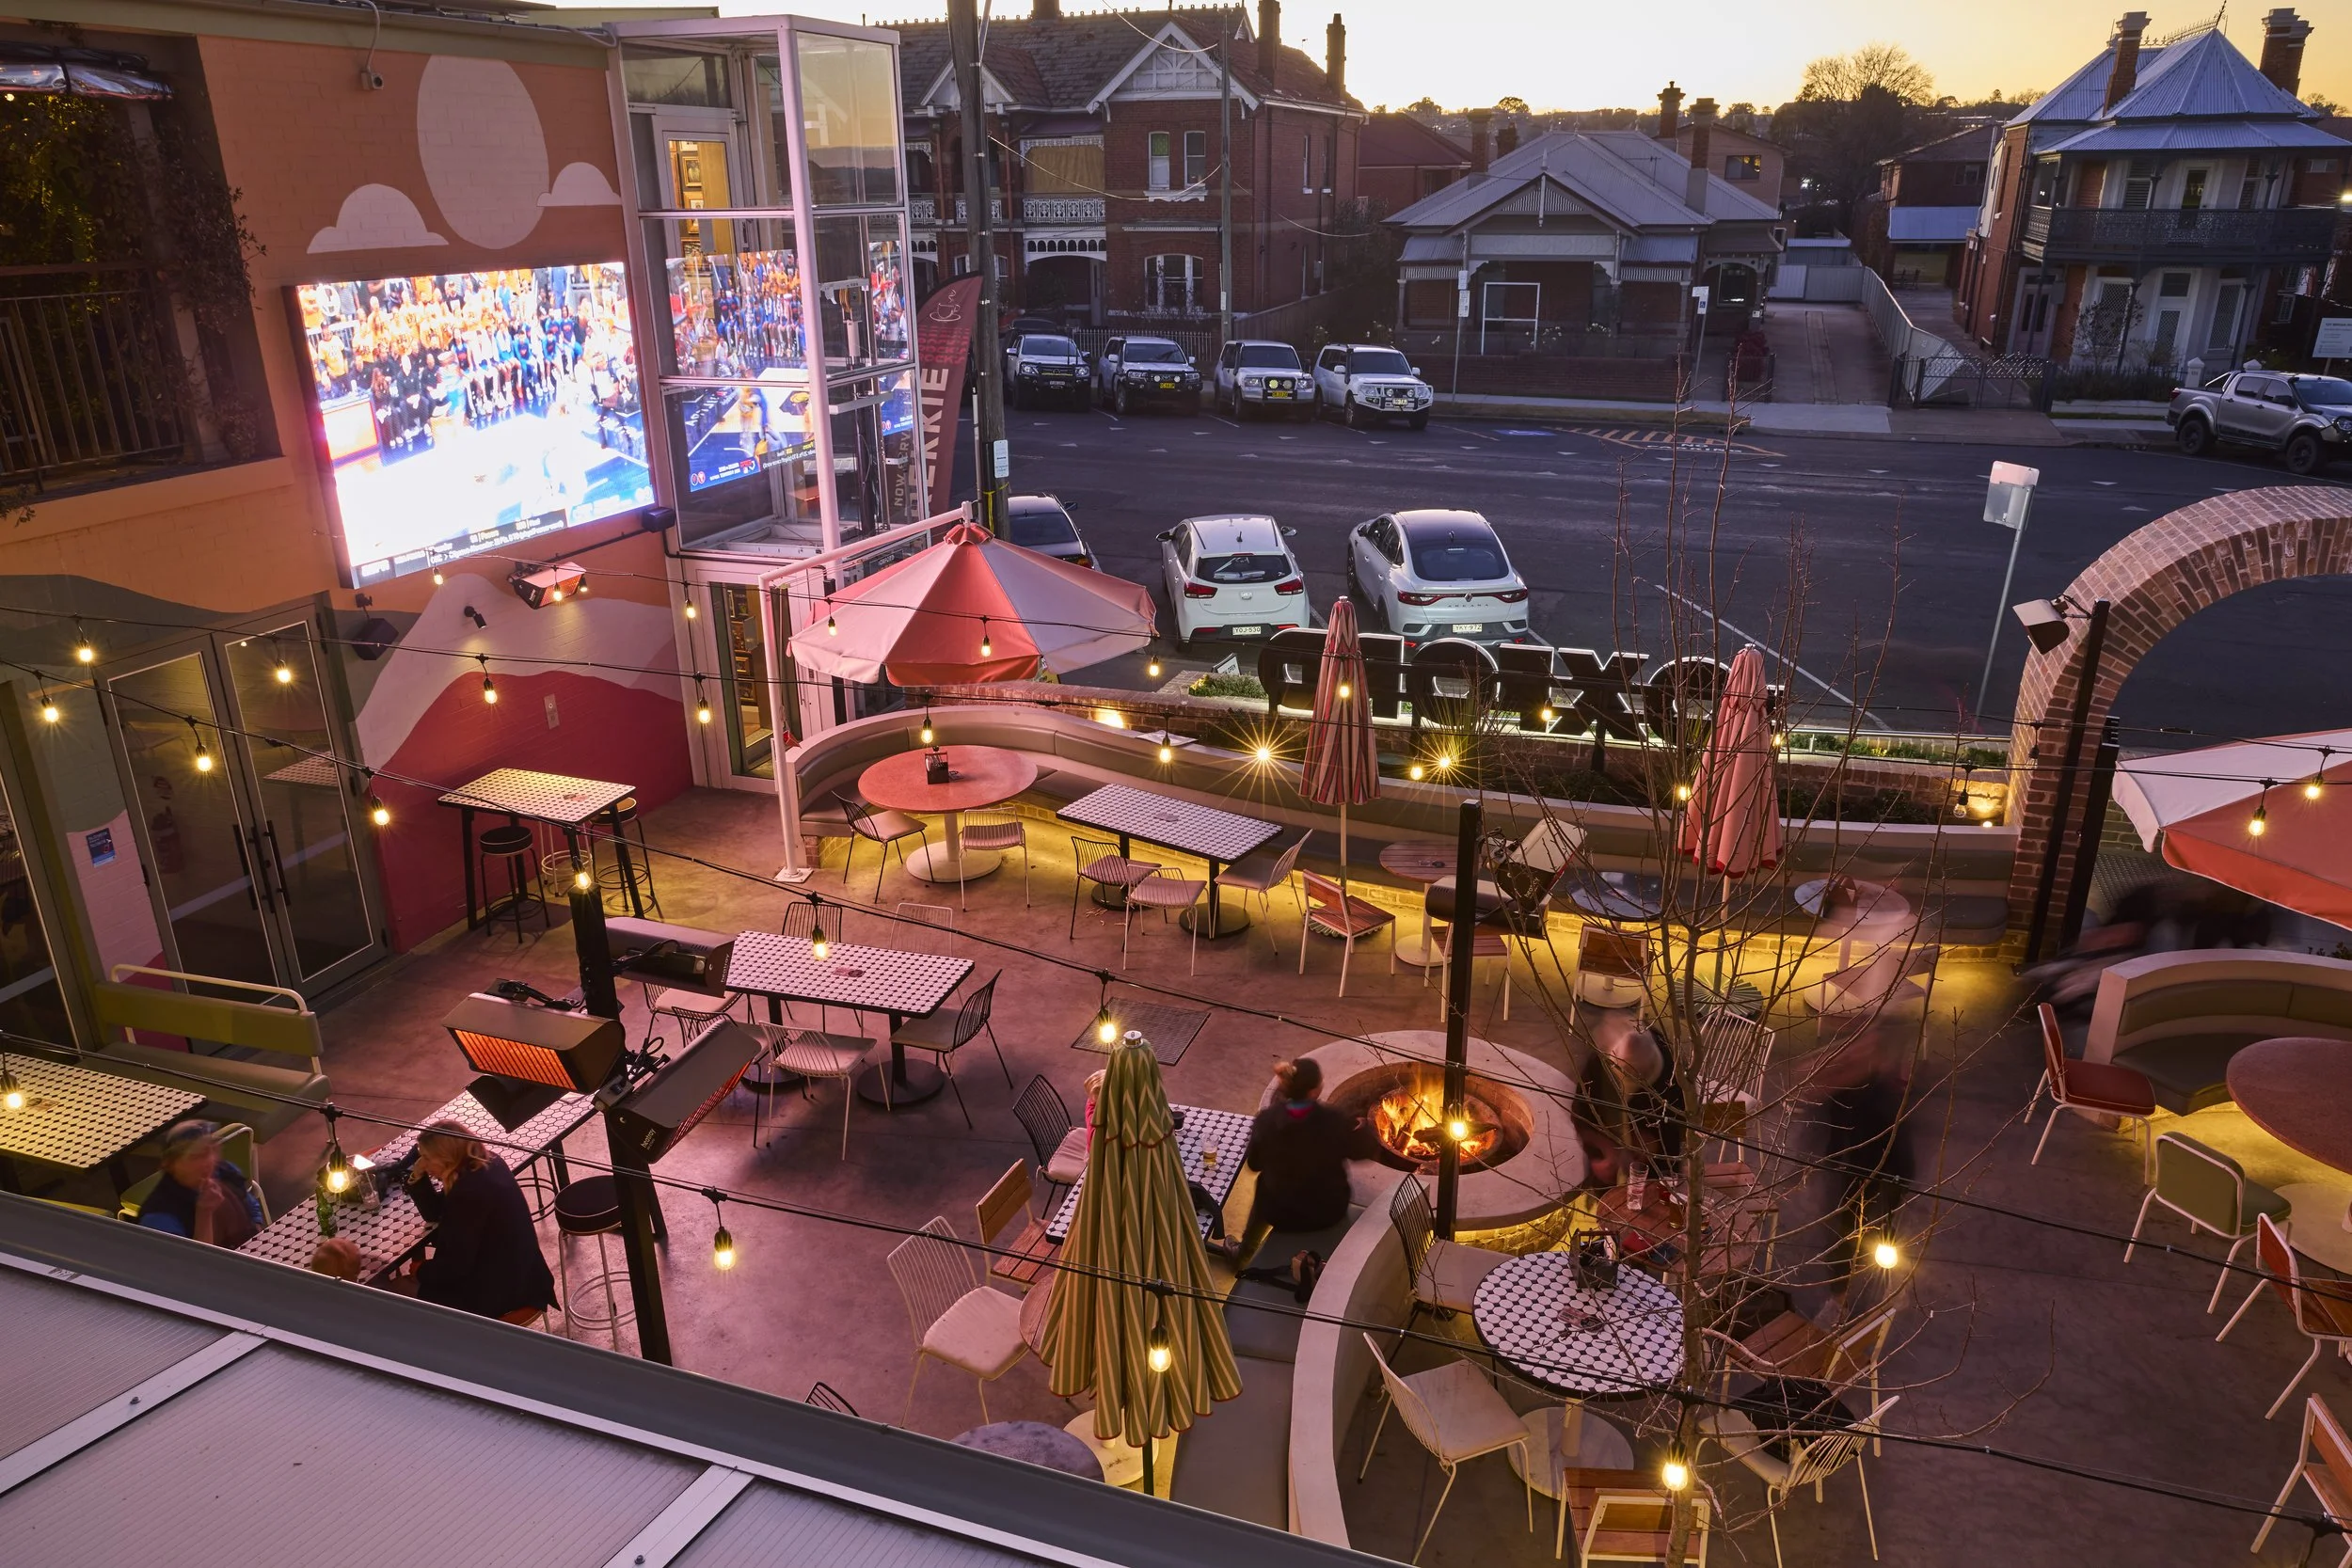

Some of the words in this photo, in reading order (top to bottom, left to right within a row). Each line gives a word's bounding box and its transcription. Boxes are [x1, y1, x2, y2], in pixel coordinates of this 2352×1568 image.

[894, 473, 906, 506] NOW
[721, 954, 730, 983] heatray
[641, 1128, 657, 1148] heatray
